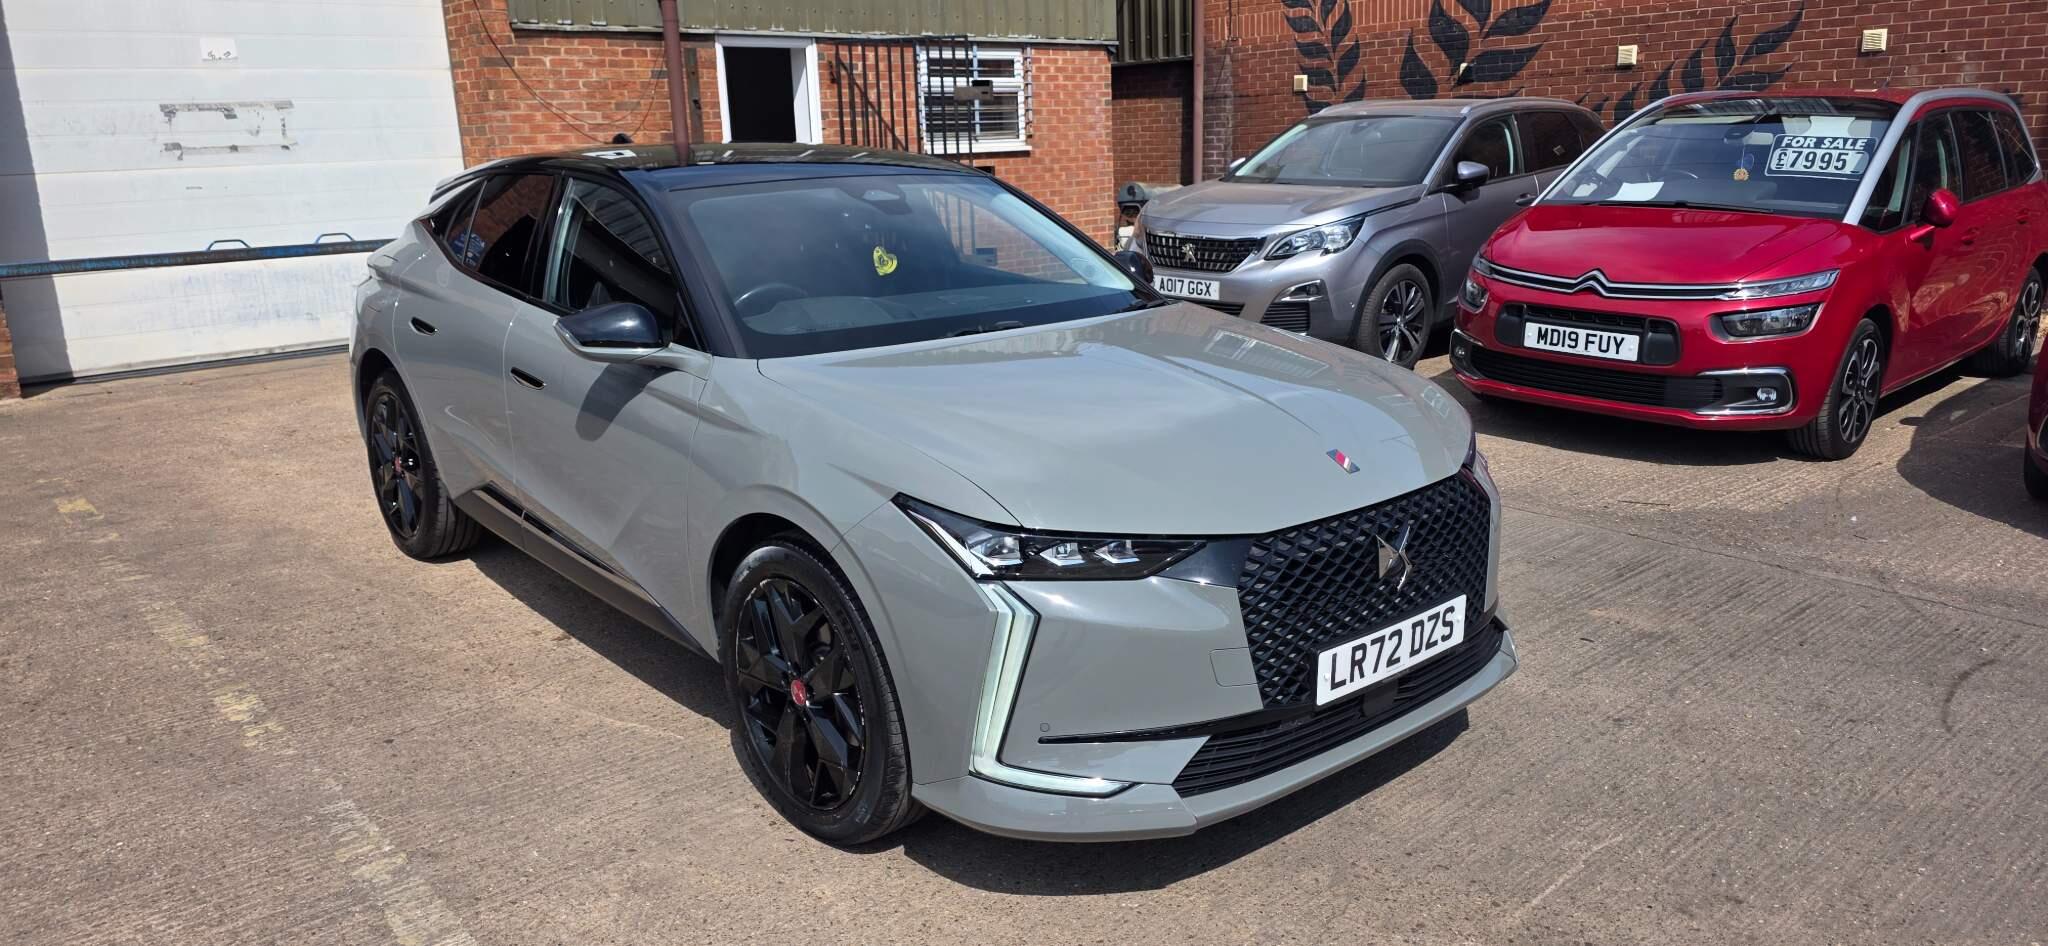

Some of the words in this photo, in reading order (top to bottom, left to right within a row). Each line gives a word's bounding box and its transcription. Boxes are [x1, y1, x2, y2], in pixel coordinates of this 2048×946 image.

[1781, 136, 1816, 148] FOR
[1821, 138, 1867, 150] SALE
[1775, 150, 1849, 171] £7995
[1159, 277, 1185, 294] AO17
[1187, 280, 1212, 297] GGX
[1536, 326, 1579, 349] MD19
[1584, 333, 1625, 355] FUY
[1330, 628, 1403, 691] LR72
[1409, 605, 1456, 658] DZS
